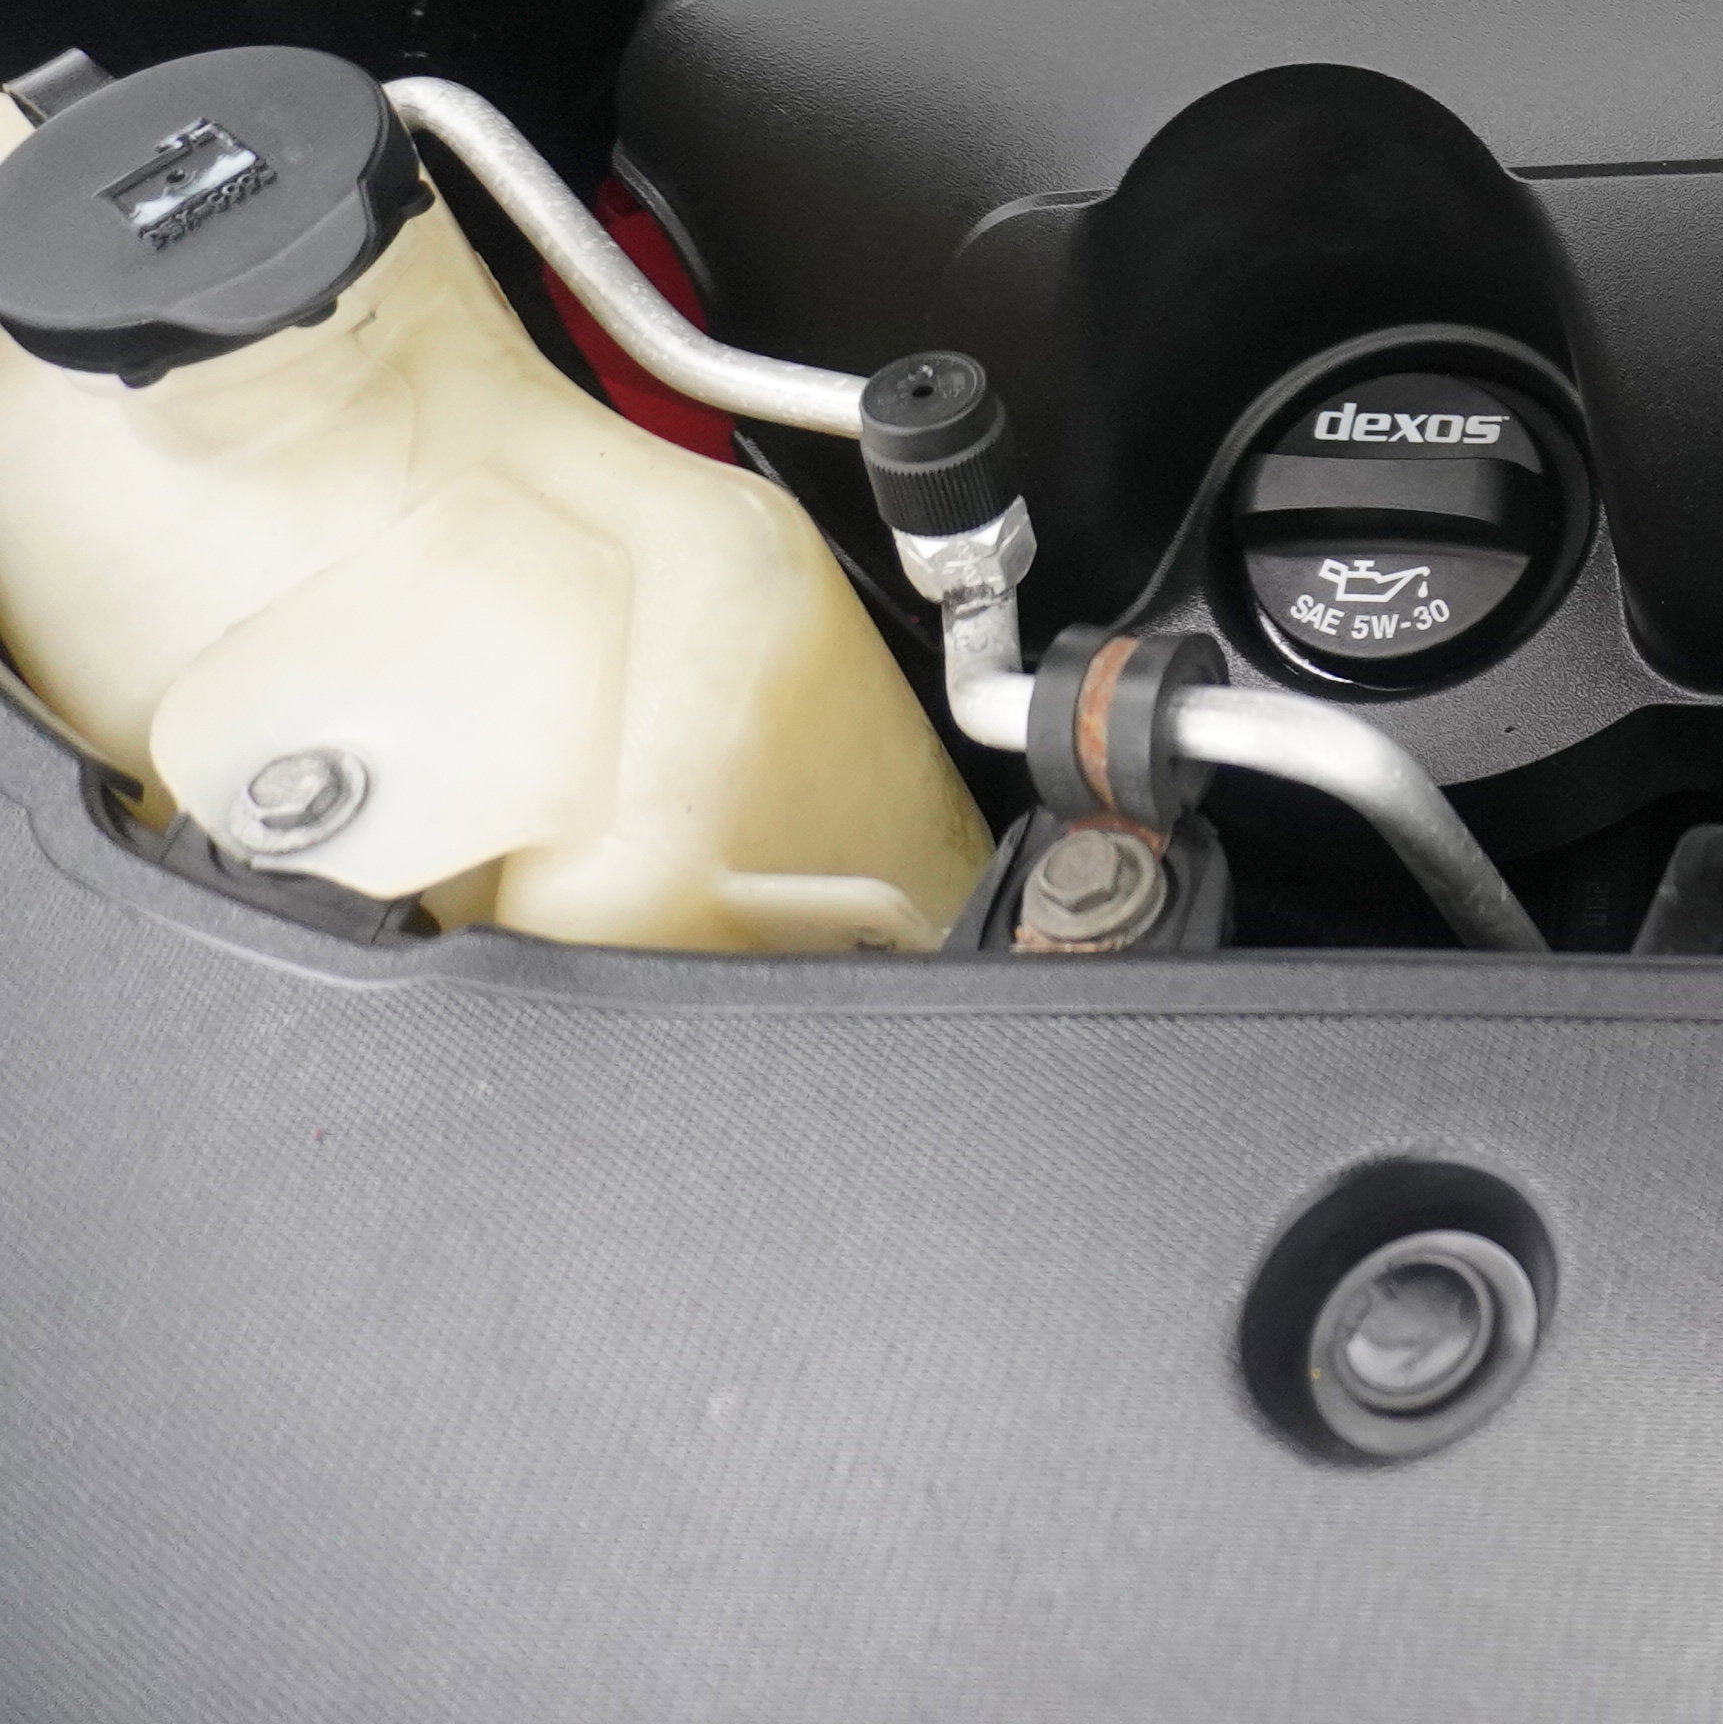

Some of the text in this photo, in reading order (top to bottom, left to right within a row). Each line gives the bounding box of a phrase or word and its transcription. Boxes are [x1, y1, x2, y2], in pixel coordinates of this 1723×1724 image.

[1313, 402, 1503, 445] dexos
[1289, 593, 1451, 641] SAE 5W-30
